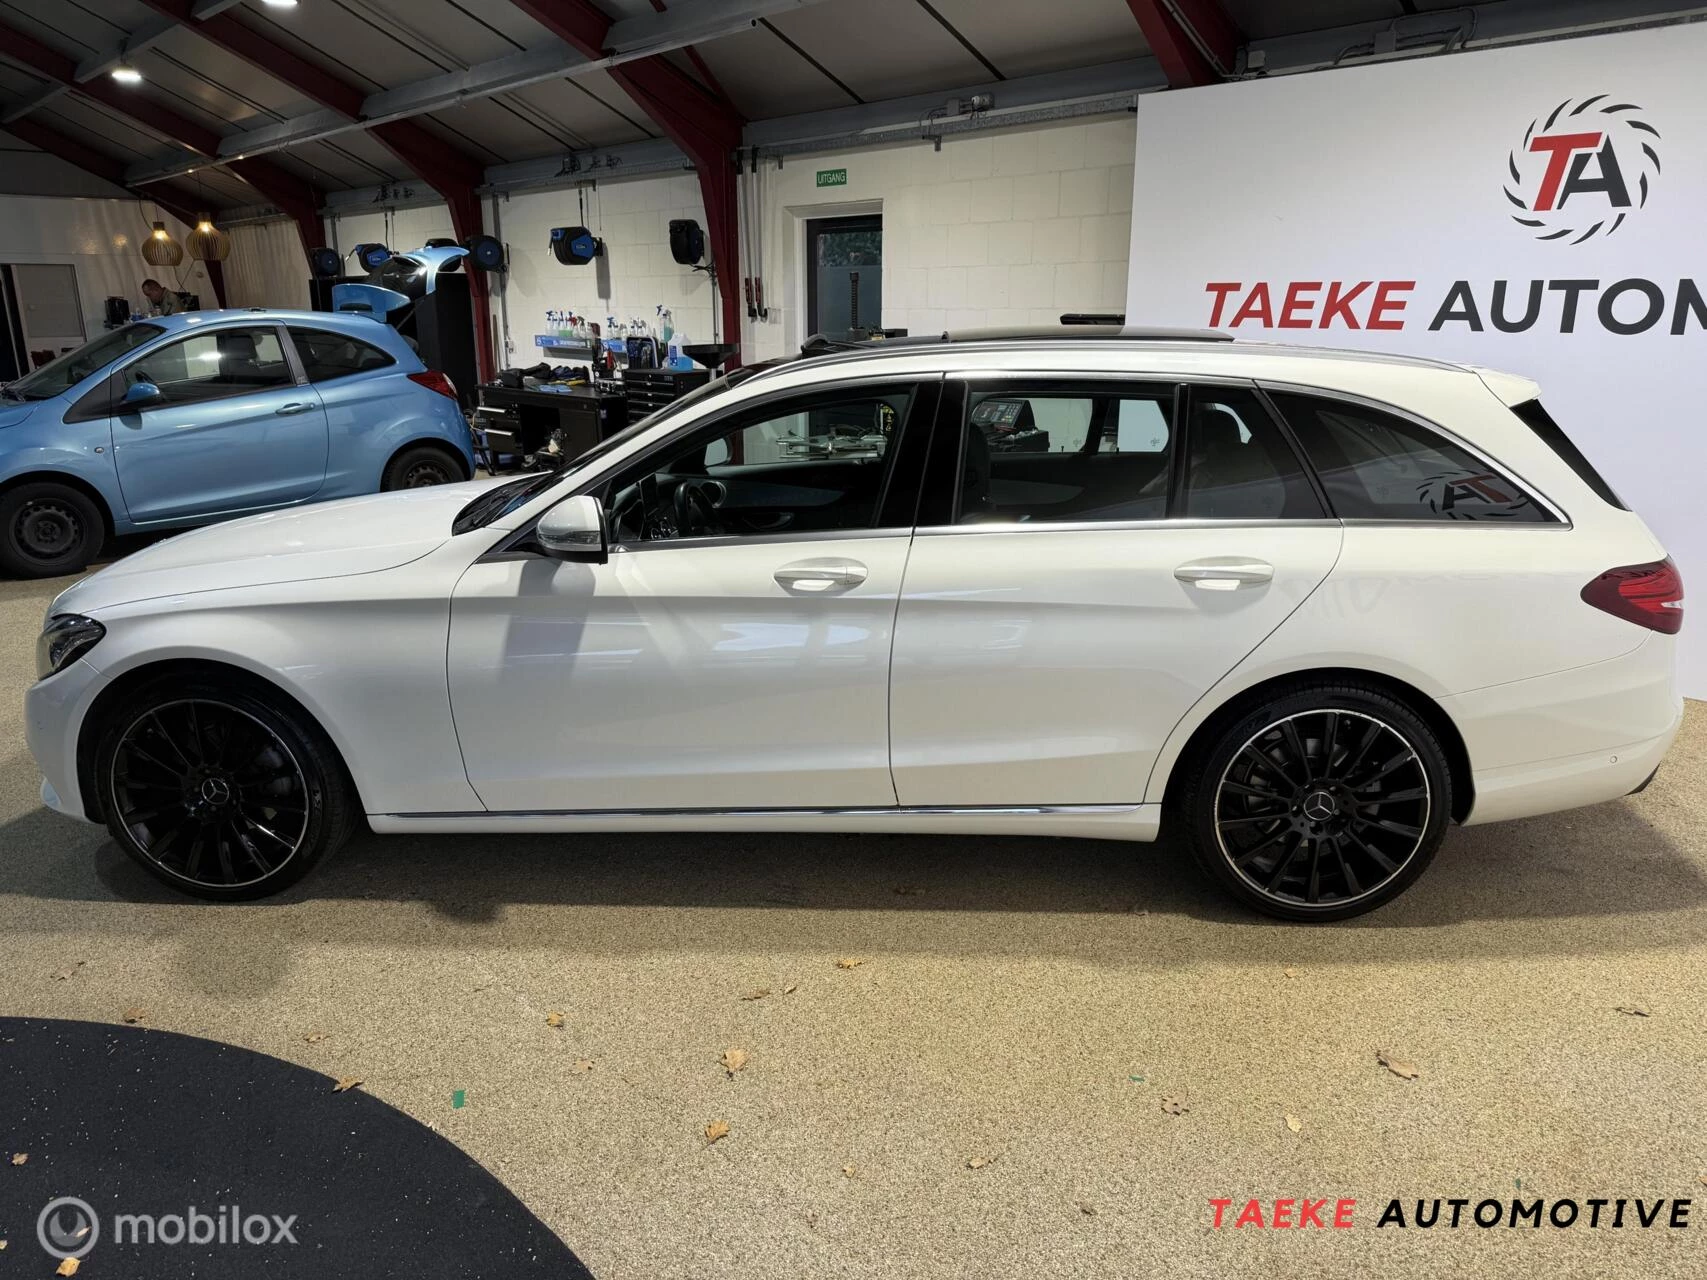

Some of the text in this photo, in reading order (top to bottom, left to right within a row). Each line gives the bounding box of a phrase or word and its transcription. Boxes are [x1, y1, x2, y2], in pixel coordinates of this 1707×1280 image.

[818, 172, 846, 184] UITGANG
[1530, 131, 1633, 212] TA
[1206, 281, 1415, 330] TAEKE
